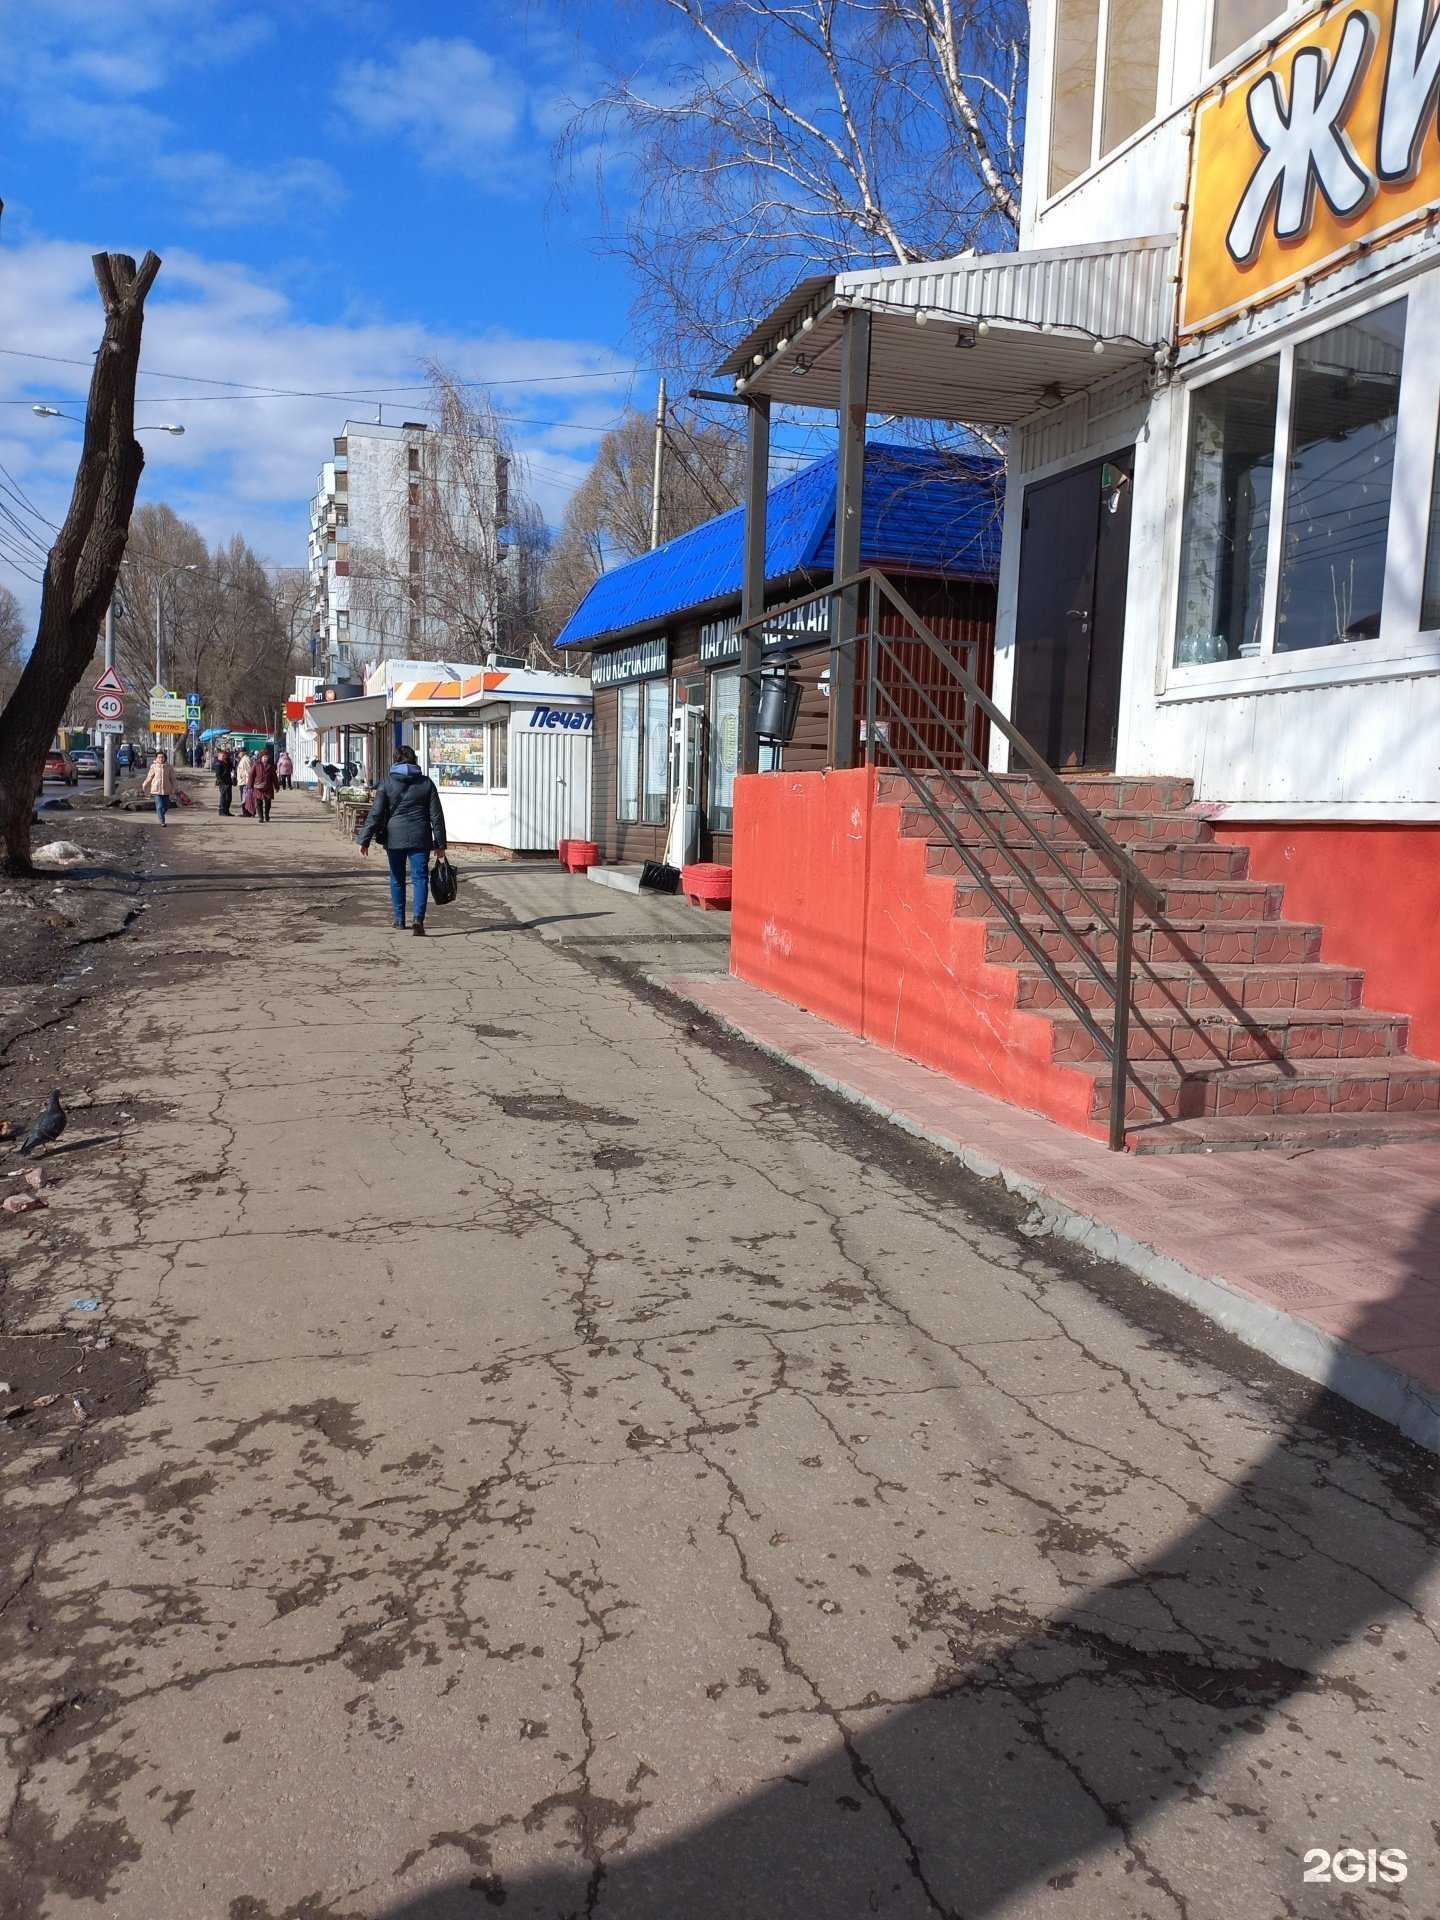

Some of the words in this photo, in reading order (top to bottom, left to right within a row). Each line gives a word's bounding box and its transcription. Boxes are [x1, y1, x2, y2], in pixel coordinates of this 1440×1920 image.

[700, 595, 829, 661] ПАРИКЕРСКАЯ
[592, 652, 612, 685] ФОТО
[612, 637, 666, 681] КСЕРОКОПИЯ
[101, 701, 118, 712] 40
